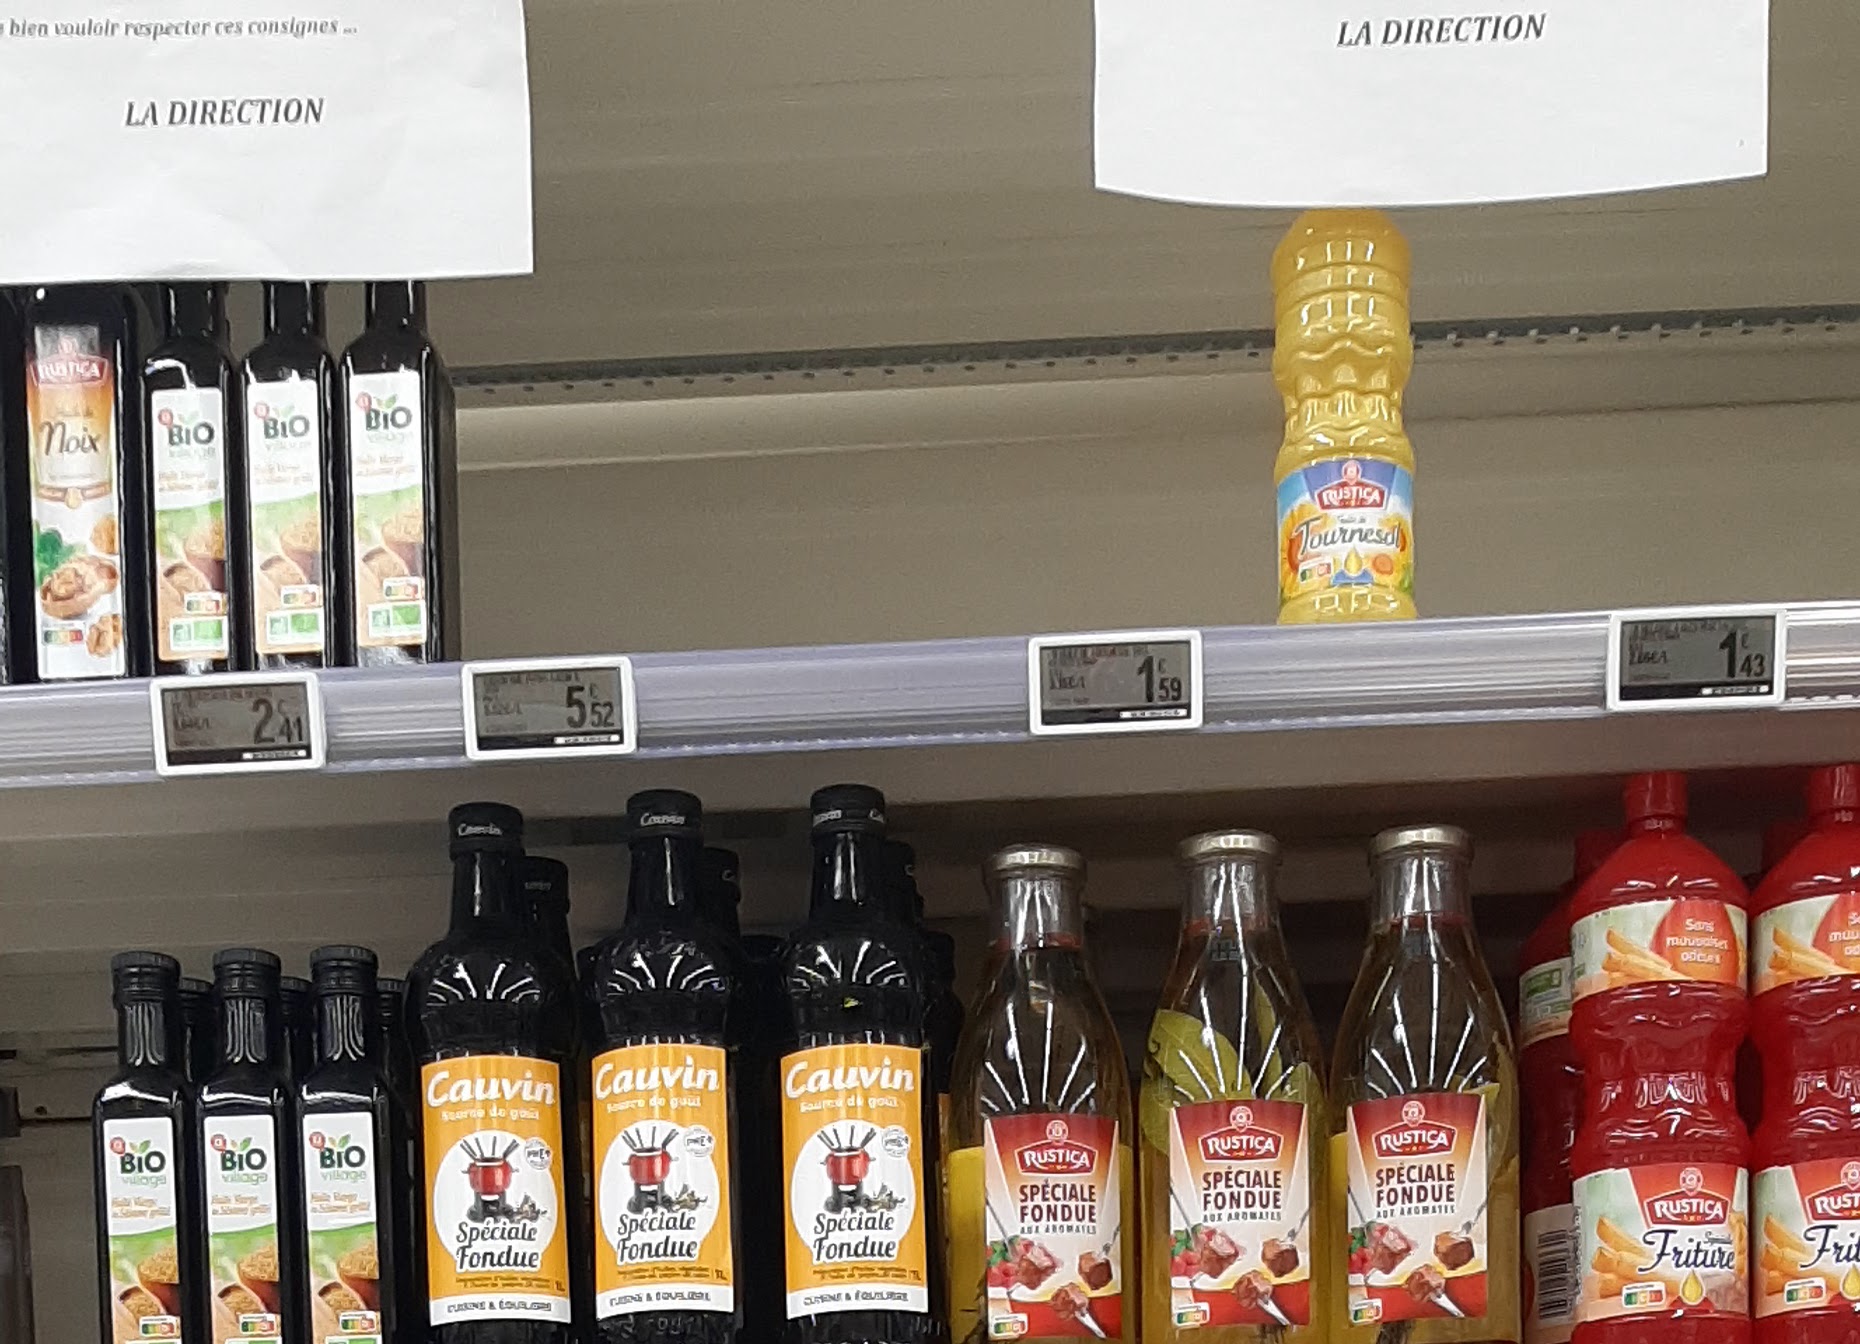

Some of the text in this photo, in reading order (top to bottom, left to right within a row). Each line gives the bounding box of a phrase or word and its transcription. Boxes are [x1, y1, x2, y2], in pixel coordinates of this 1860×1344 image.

[9, 16, 49, 37] bien
[53, 17, 120, 37] vouloir
[124, 18, 211, 41] respecter
[213, 18, 243, 37] ces
[247, 16, 339, 37] consignes
[1336, 13, 1547, 47] LA DIRECTION
[125, 97, 325, 127] LA DIRECTION
[263, 414, 310, 439] BIO
[365, 405, 413, 431] BIO
[39, 419, 102, 457] Noix
[167, 420, 215, 448] BIO
[1322, 485, 1382, 507] RUSTICA
[1294, 515, 1402, 556] Tournesol
[427, 1069, 556, 1108] Cauvin
[594, 1056, 719, 1100] Cauvin
[785, 1056, 915, 1100] Cauvin
[1206, 1135, 1276, 1157] RUSTICA
[1379, 1129, 1450, 1152] RUSTICA
[120, 1150, 167, 1175] BIO
[219, 1148, 267, 1172] BIO
[319, 1145, 366, 1169] BIO
[1022, 1149, 1090, 1169] RUSTICA
[1201, 1165, 1282, 1192] SPÉCIALE
[1375, 1161, 1456, 1188] SPÉCIALE
[1018, 1178, 1097, 1203] SPÉCIALE
[1202, 1190, 1282, 1212] FONDUE
[1375, 1183, 1456, 1209] FONDUE
[1019, 1203, 1097, 1224] FONDUE
[1653, 1198, 1724, 1219] RUSTICA
[456, 1219, 538, 1244] Spéciale
[617, 1210, 697, 1237] Spéciale
[814, 1211, 895, 1237] Spéciale
[456, 1245, 540, 1270] Fondue
[617, 1235, 699, 1263] Fondue
[813, 1235, 897, 1262] Fondue
[1638, 1228, 1735, 1273] Friture
